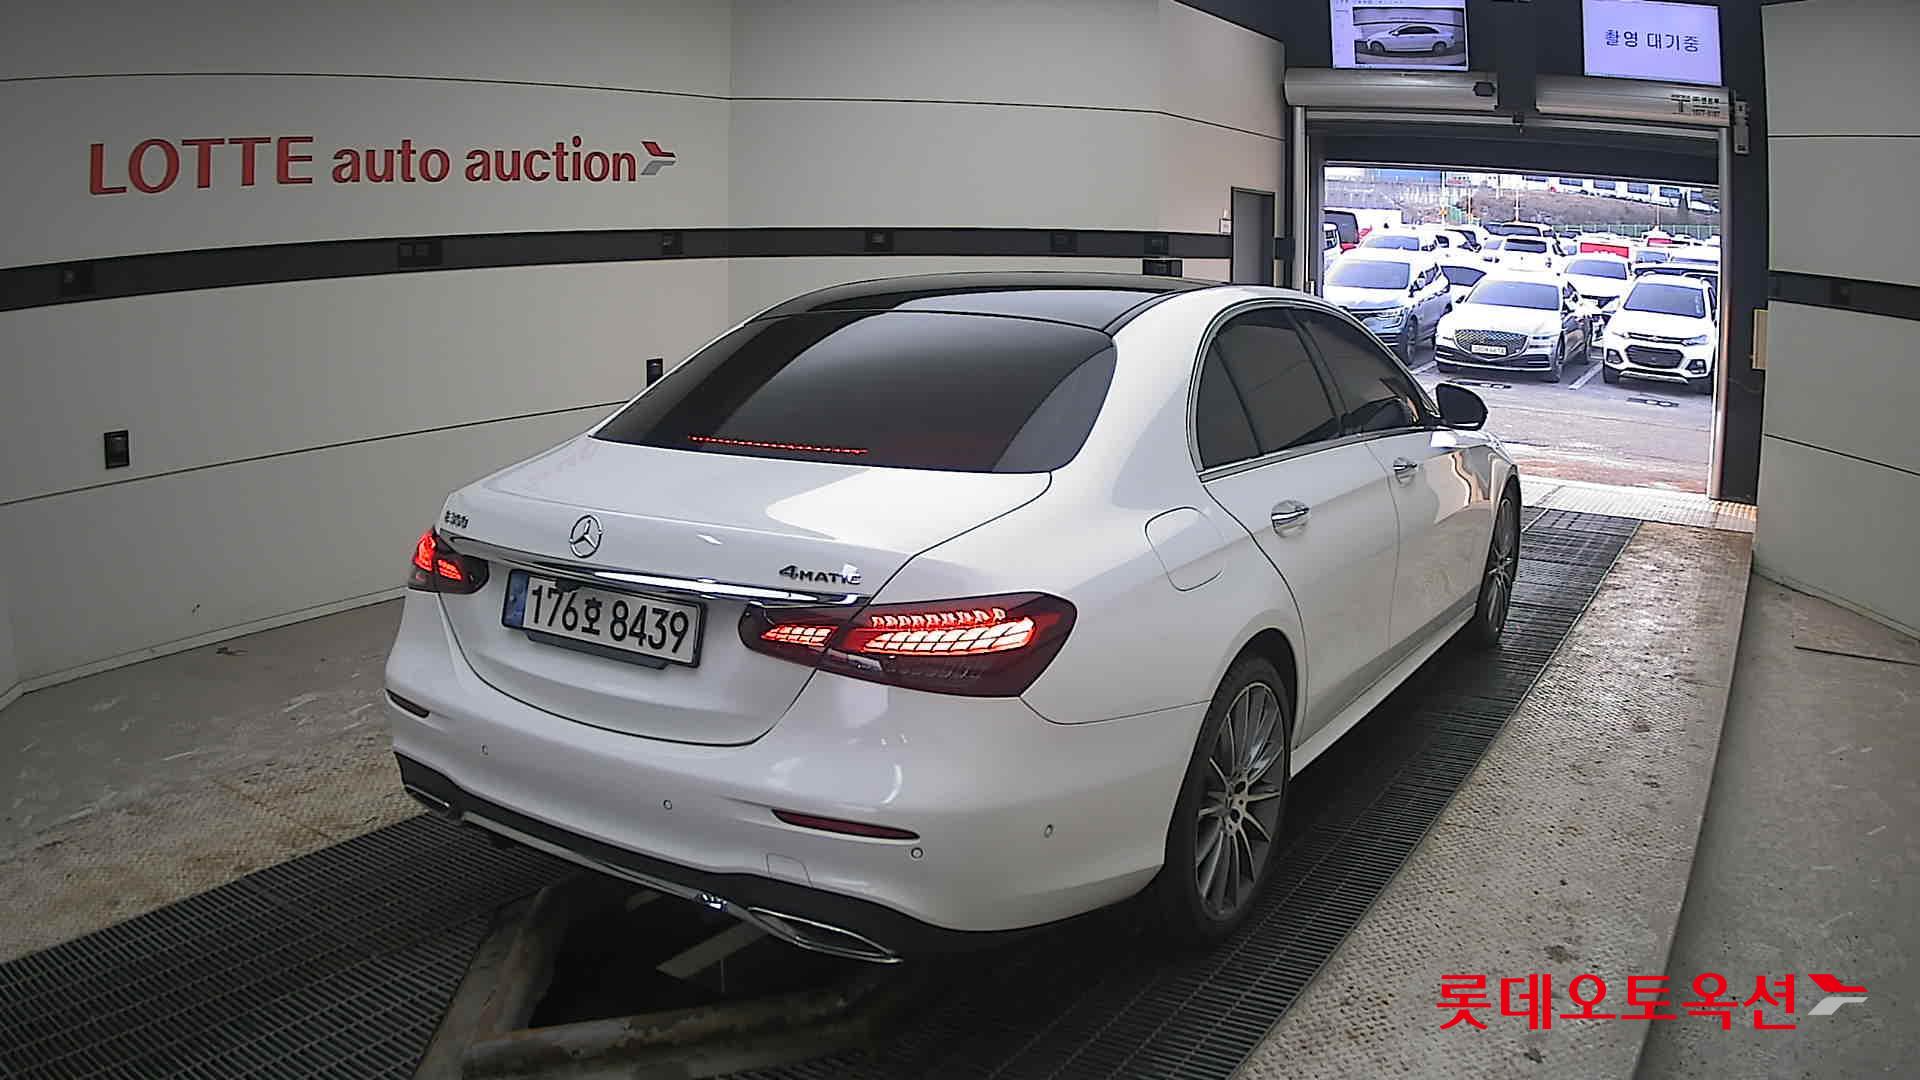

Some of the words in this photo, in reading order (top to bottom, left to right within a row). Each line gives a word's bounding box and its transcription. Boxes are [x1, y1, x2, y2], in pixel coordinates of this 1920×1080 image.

[1647, 33, 1699, 53] 대기중
[89, 136, 314, 195] LOTTE
[332, 139, 450, 183] auto
[464, 136, 637, 182] auction
[531, 585, 602, 636] 176호
[610, 600, 689, 654] 8439
